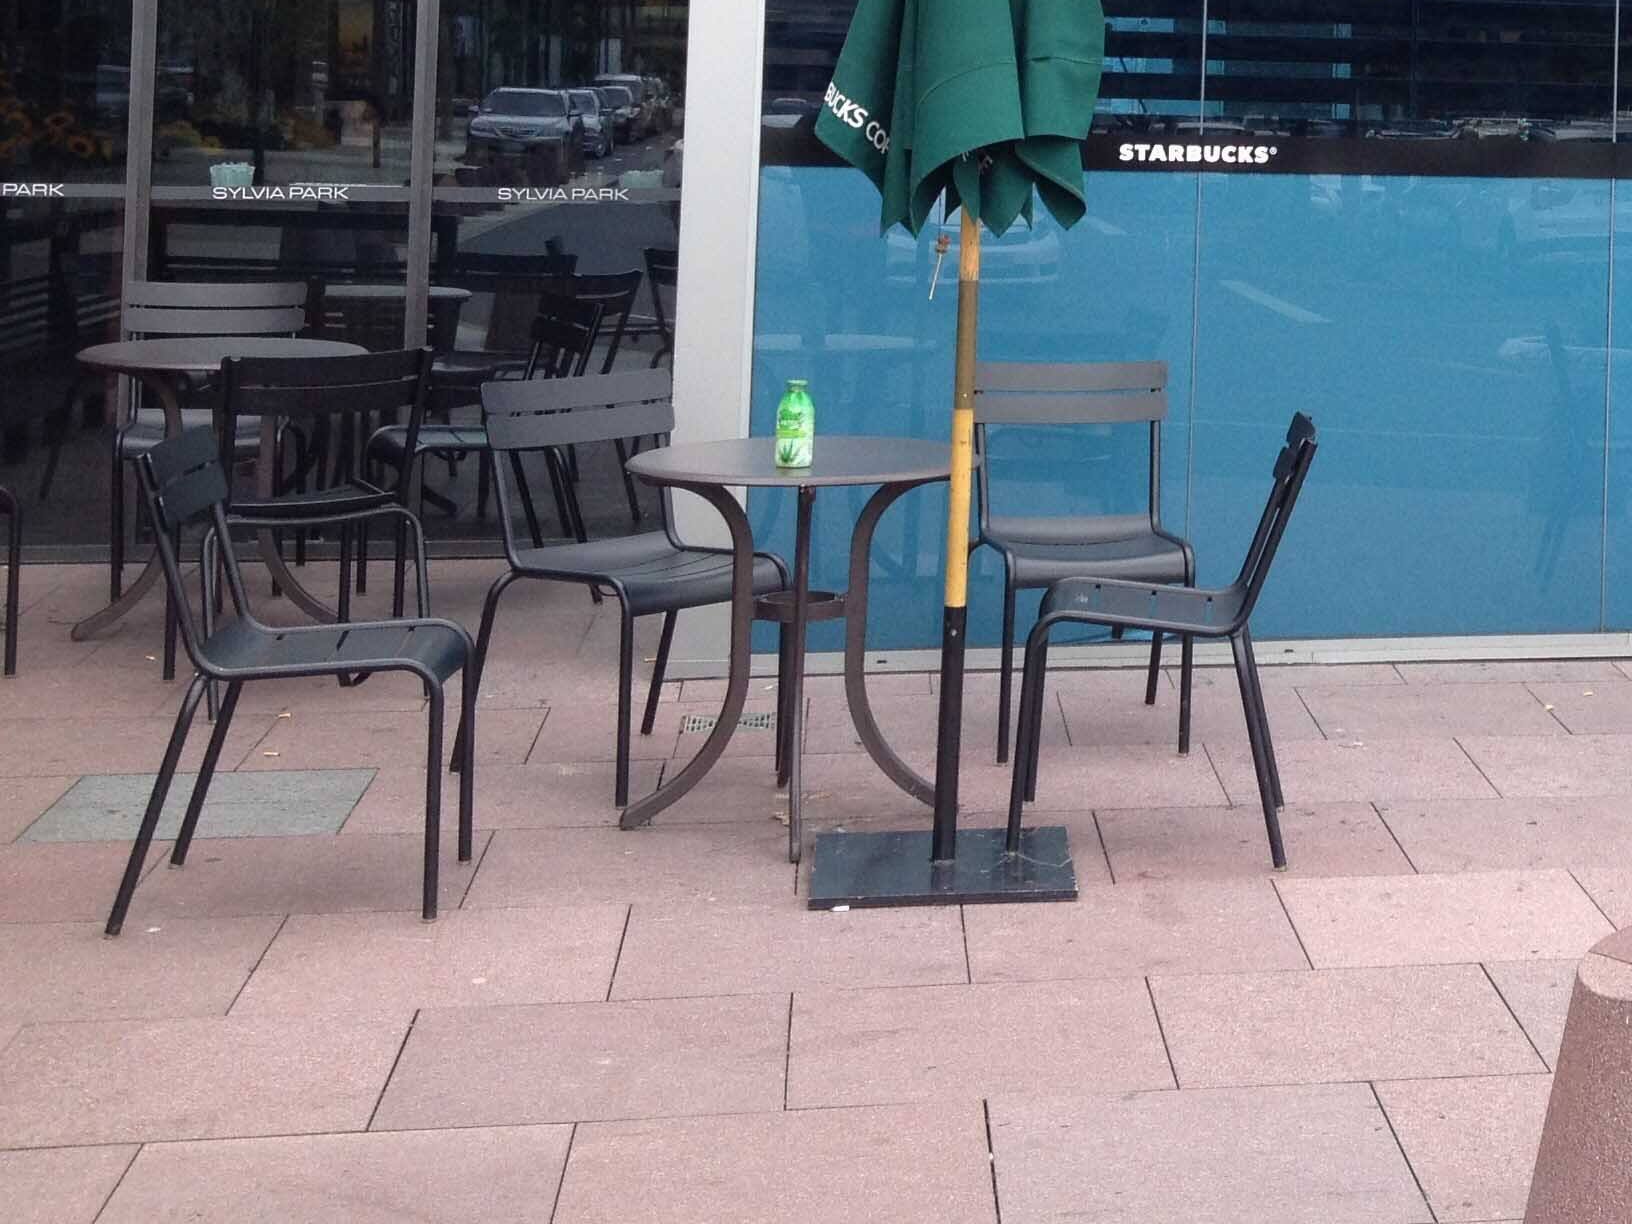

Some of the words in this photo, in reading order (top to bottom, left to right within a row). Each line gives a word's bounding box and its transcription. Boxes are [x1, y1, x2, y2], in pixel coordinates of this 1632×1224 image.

[2, 183, 65, 197] PARK
[212, 186, 286, 200] SYLVIA
[288, 186, 349, 200] PARK
[497, 187, 568, 201] SYLVIA
[571, 187, 630, 201] PARK
